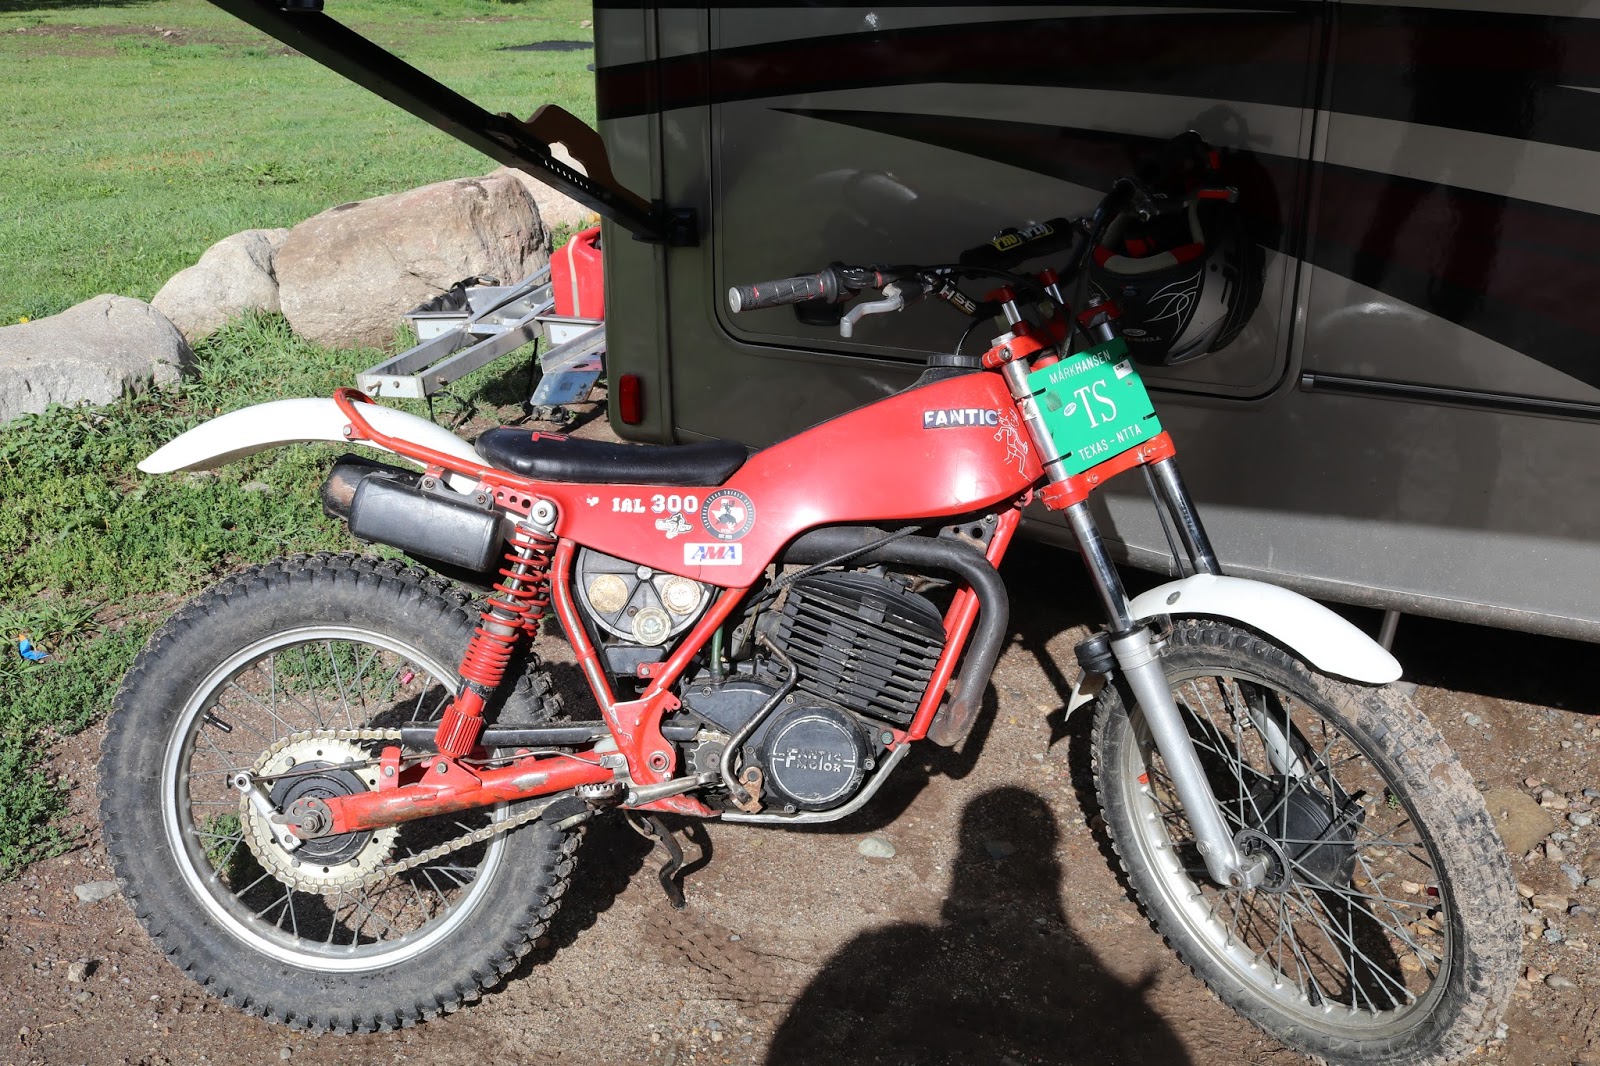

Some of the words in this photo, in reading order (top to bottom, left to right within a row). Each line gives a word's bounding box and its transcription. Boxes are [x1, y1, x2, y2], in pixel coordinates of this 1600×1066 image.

[1074, 379, 1117, 429] TS
[924, 409, 998, 426] FANTIC
[1078, 439, 1109, 461] TEXAS
[651, 494, 698, 514] 300
[691, 546, 736, 559] AMA
